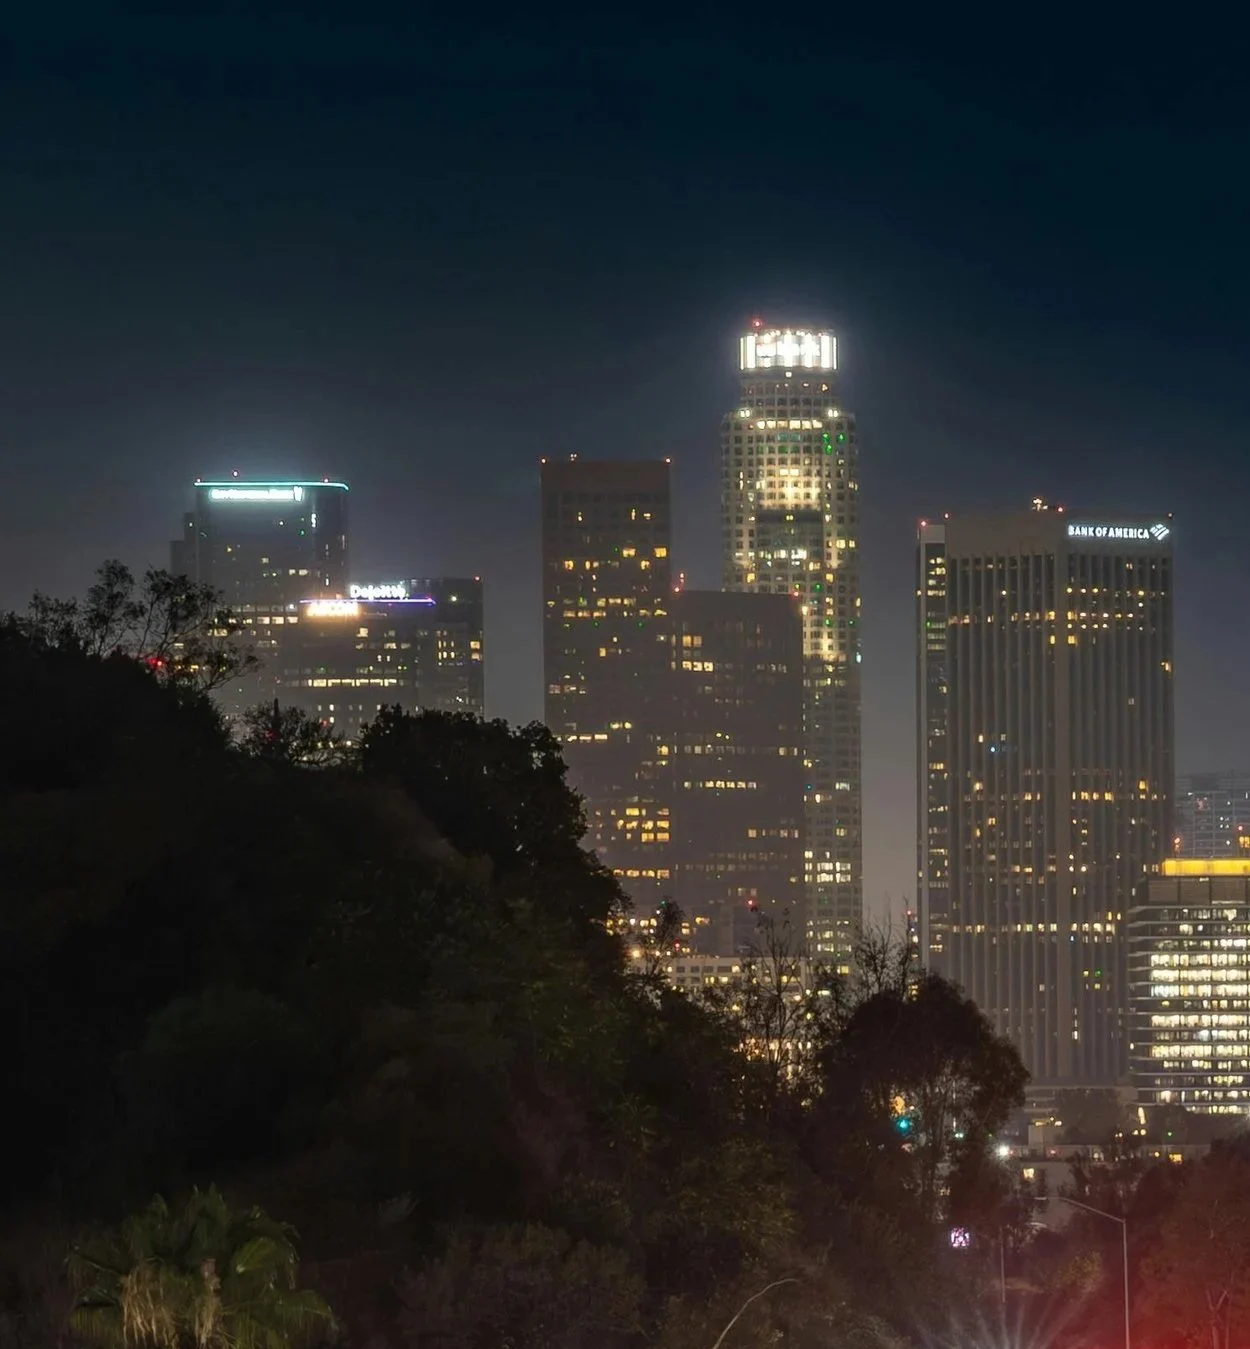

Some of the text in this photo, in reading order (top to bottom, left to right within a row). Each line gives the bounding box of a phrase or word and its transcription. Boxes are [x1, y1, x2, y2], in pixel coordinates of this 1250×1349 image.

[1068, 525, 1150, 540] BANK OF AMERICA
